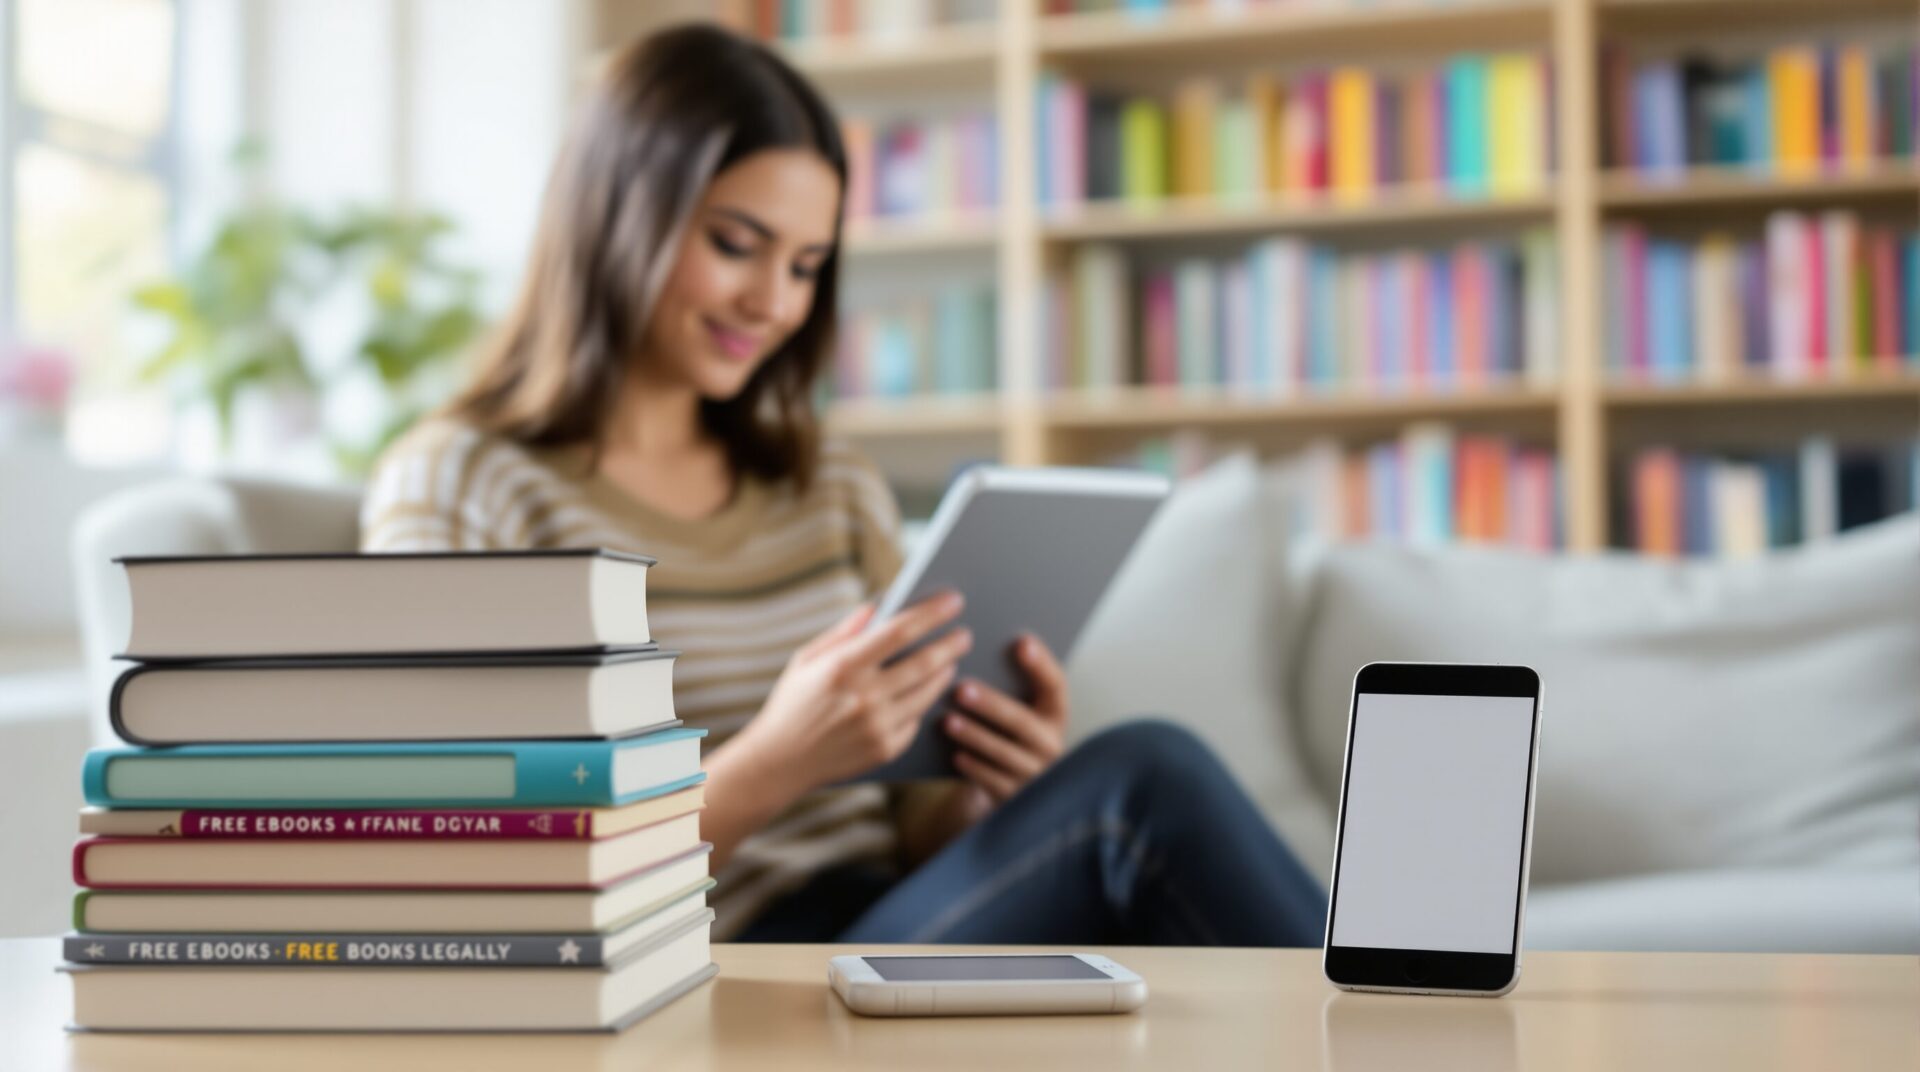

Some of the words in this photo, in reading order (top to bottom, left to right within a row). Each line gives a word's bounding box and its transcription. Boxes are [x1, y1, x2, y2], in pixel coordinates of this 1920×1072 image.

[198, 816, 247, 832] FREE
[255, 816, 336, 832] EBOOKS
[128, 942, 179, 960] FREE
[186, 942, 271, 960] EBOOKS
[285, 942, 339, 961] FREE
[346, 942, 416, 960] BOOKS
[421, 943, 511, 961] LEGALLY
